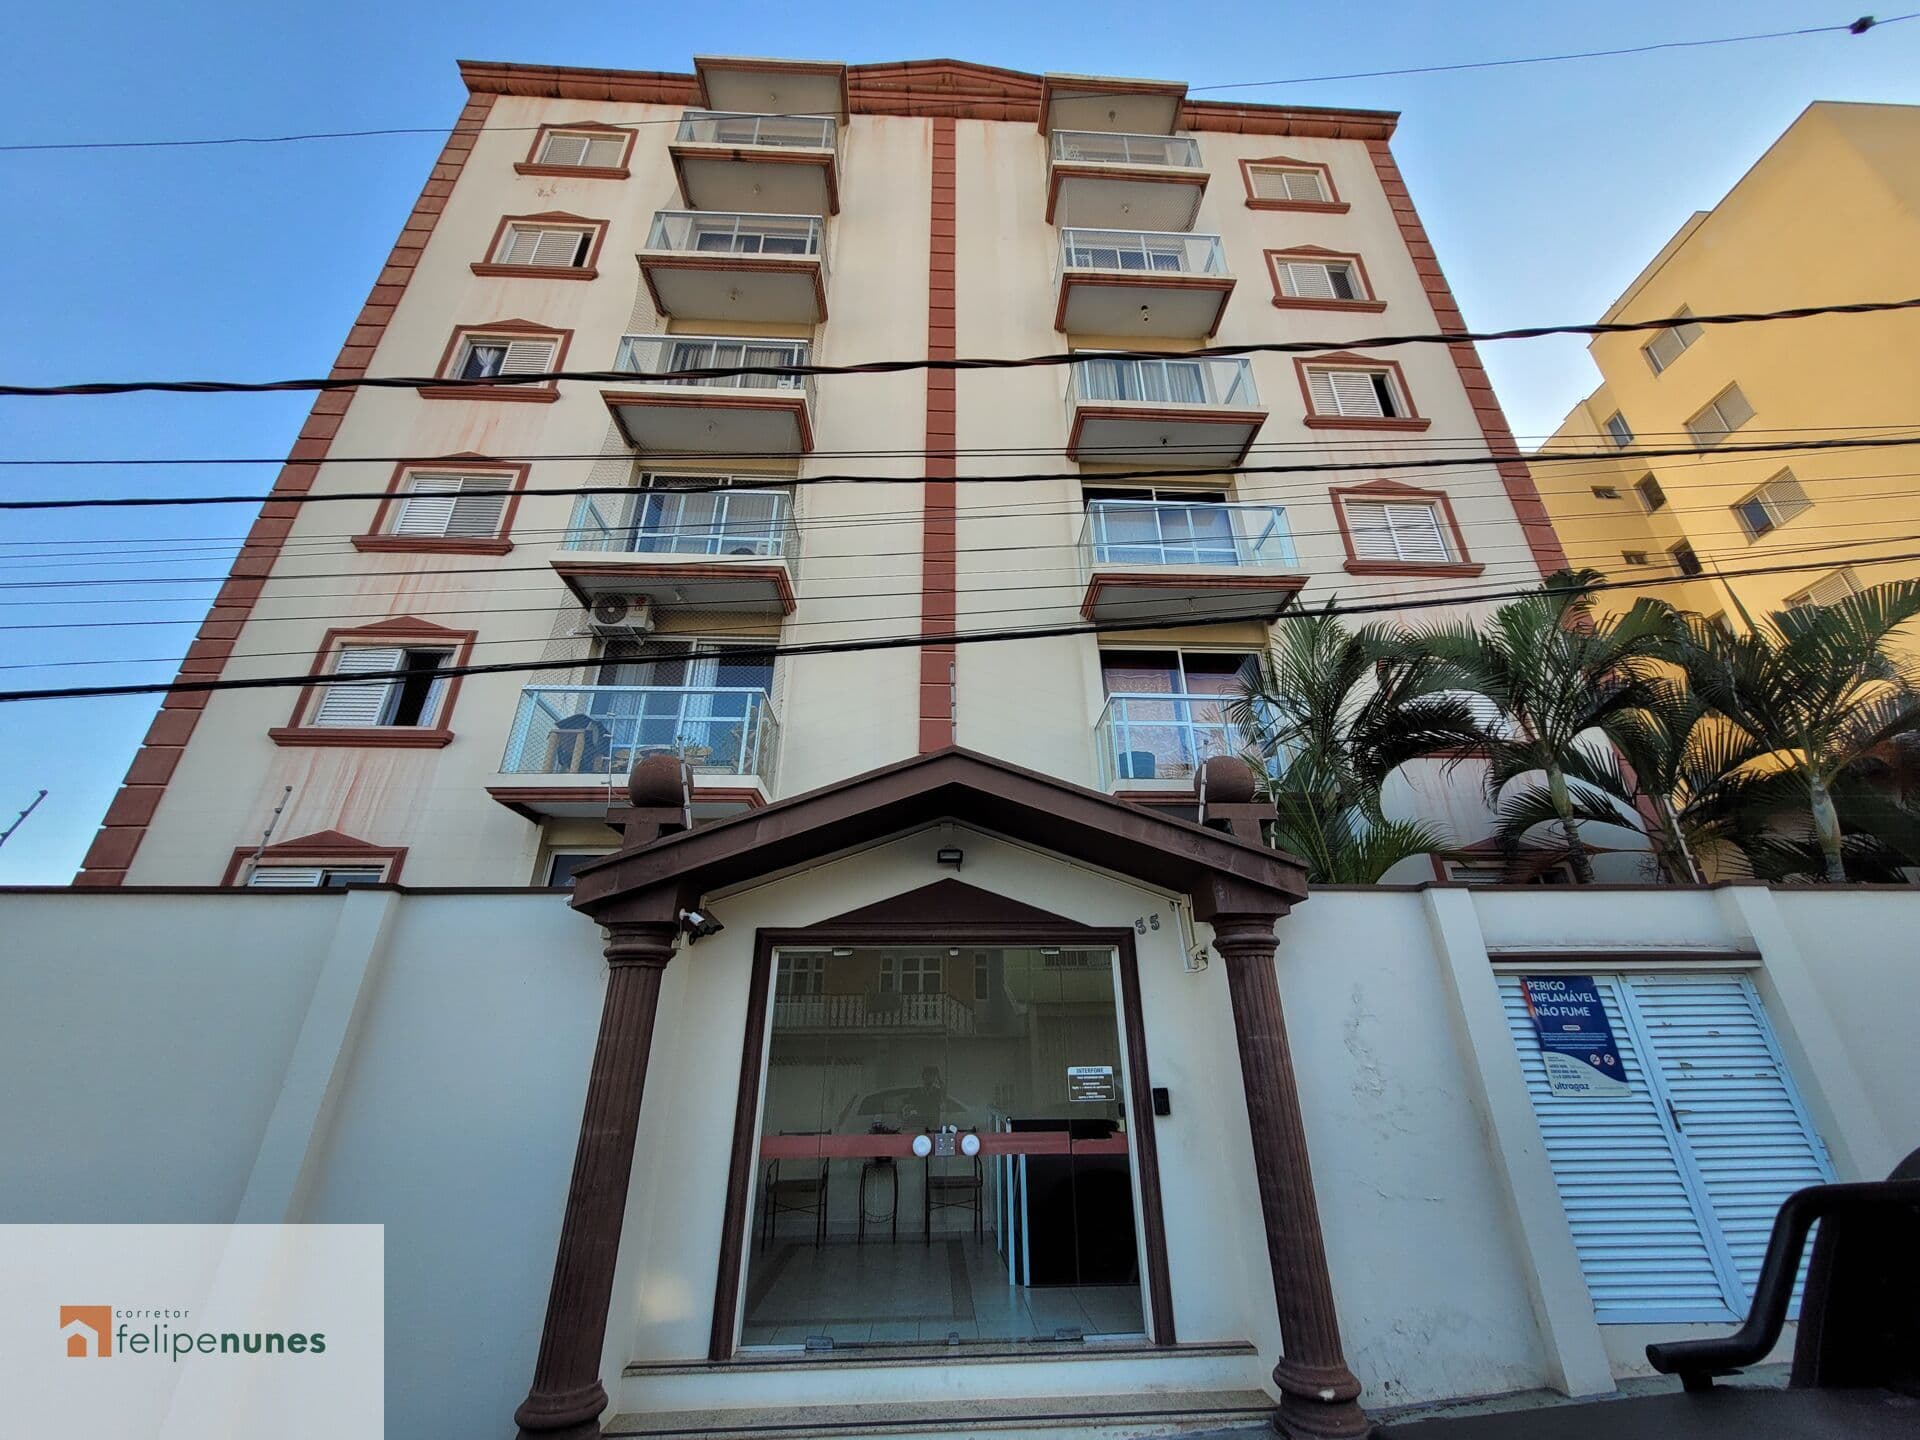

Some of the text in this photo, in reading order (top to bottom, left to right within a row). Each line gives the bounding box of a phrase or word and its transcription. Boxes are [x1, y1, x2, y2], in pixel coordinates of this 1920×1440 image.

[1527, 981, 1566, 991] PERIGO
[1530, 990, 1597, 1003] INFLAMÁVEL
[1535, 1004, 1591, 1017] NÃO FUME
[1554, 1082, 1590, 1092] ultragaz
